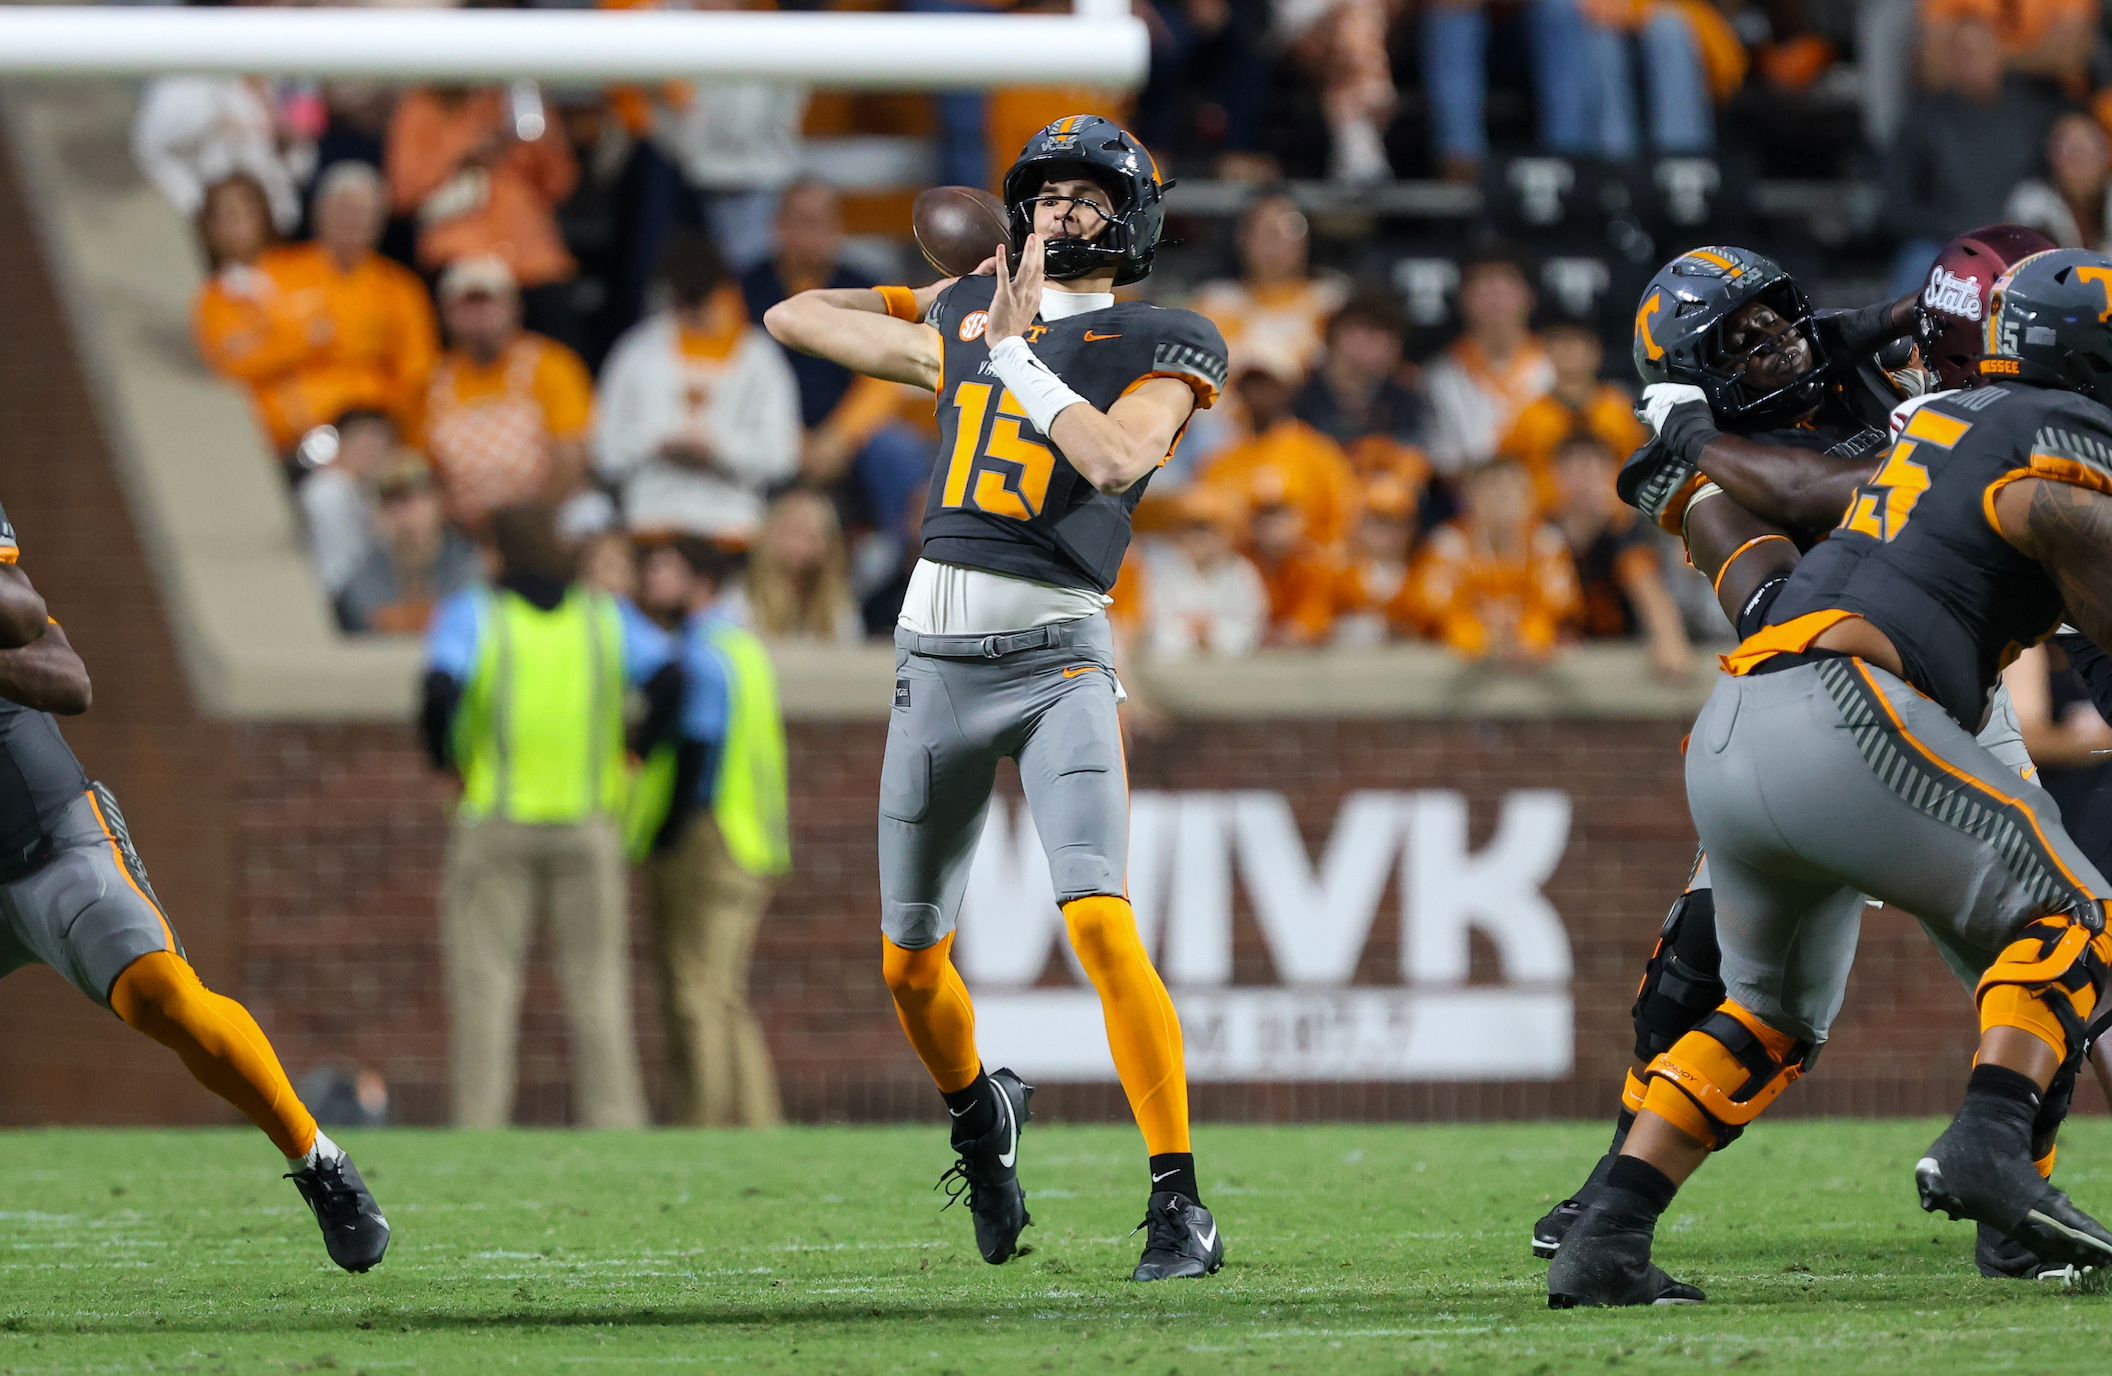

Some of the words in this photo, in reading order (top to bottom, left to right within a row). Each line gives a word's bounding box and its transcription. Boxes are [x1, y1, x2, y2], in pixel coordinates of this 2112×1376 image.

[1925, 265, 1982, 320] State
[961, 313, 989, 339] SEC
[1027, 324, 1049, 343] T
[941, 381, 1055, 521] 15
[958, 788, 1573, 986] WIVK
